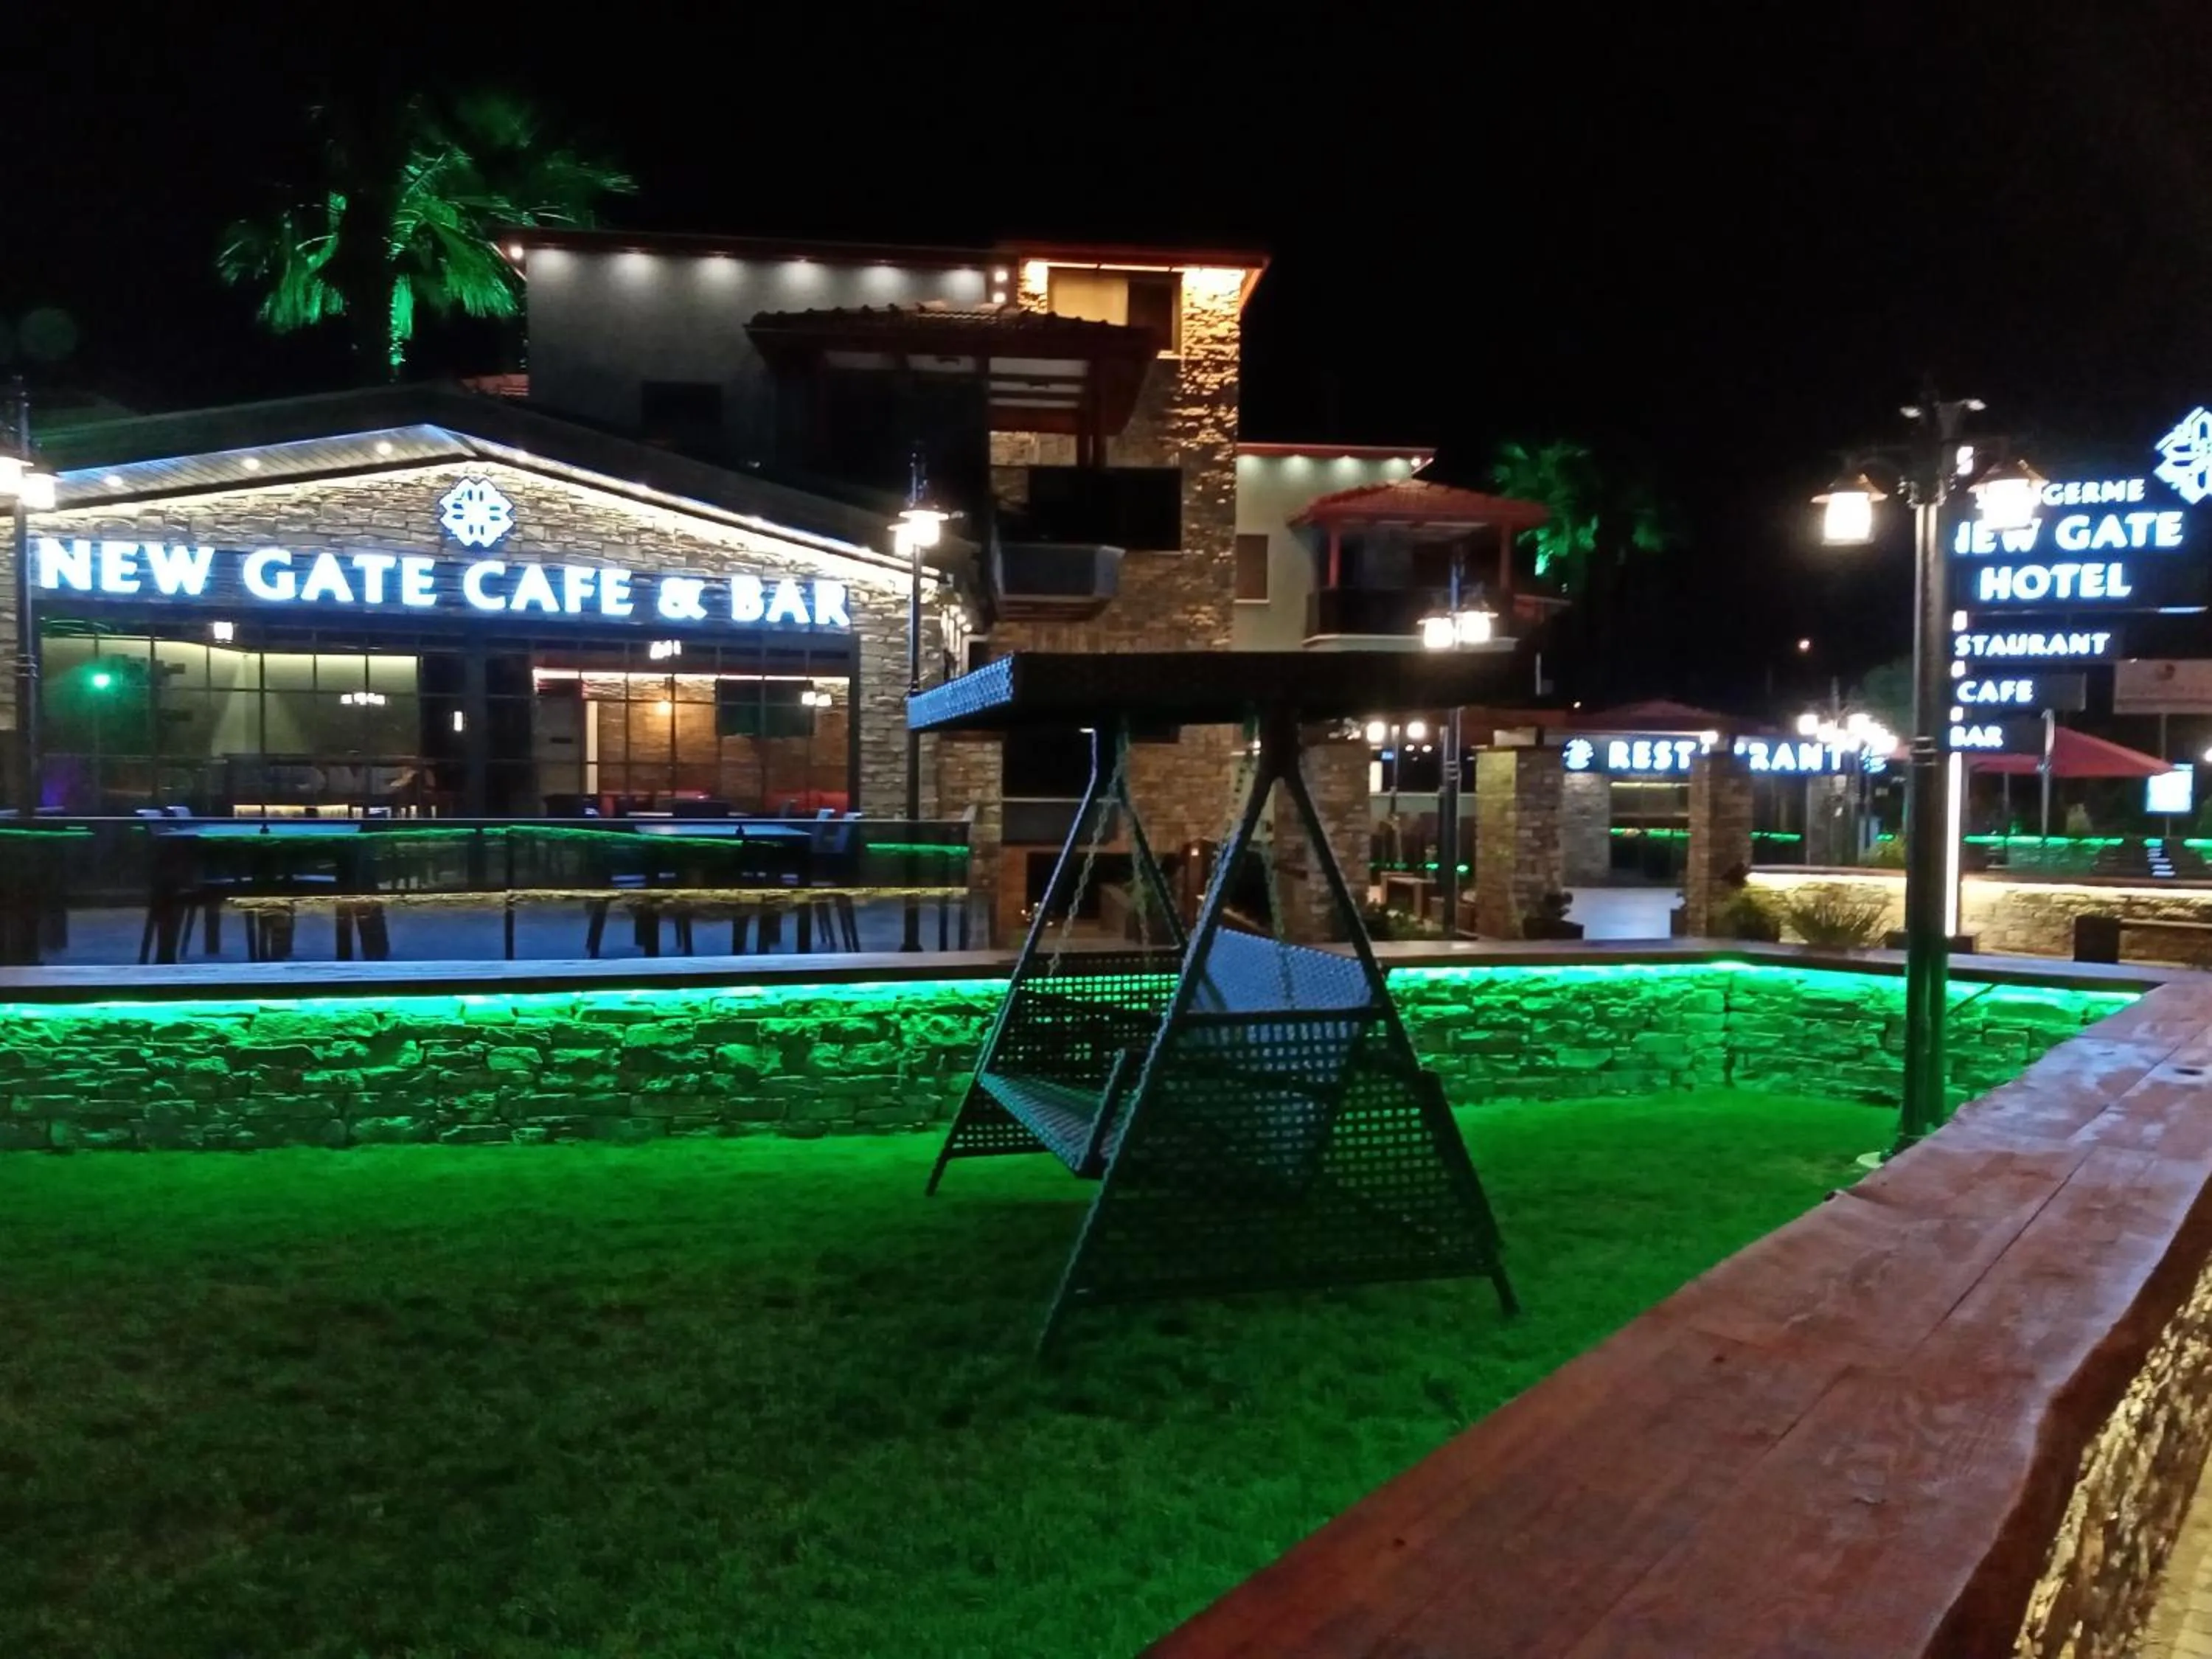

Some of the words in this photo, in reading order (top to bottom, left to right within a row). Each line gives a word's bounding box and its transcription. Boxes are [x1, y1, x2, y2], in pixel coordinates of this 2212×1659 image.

[2055, 512, 2183, 550] GATE
[38, 538, 215, 597] NEW
[243, 548, 437, 605] GATE
[462, 560, 634, 616] CAFE
[658, 577, 708, 621] &
[730, 574, 851, 626] BAR
[1979, 563, 2132, 600] HOTEL
[1955, 633, 2111, 657] STAURANT
[1956, 680, 2034, 703] CAFE
[1949, 725, 2003, 748] BAR
[1608, 740, 1843, 771] RESTRANT
